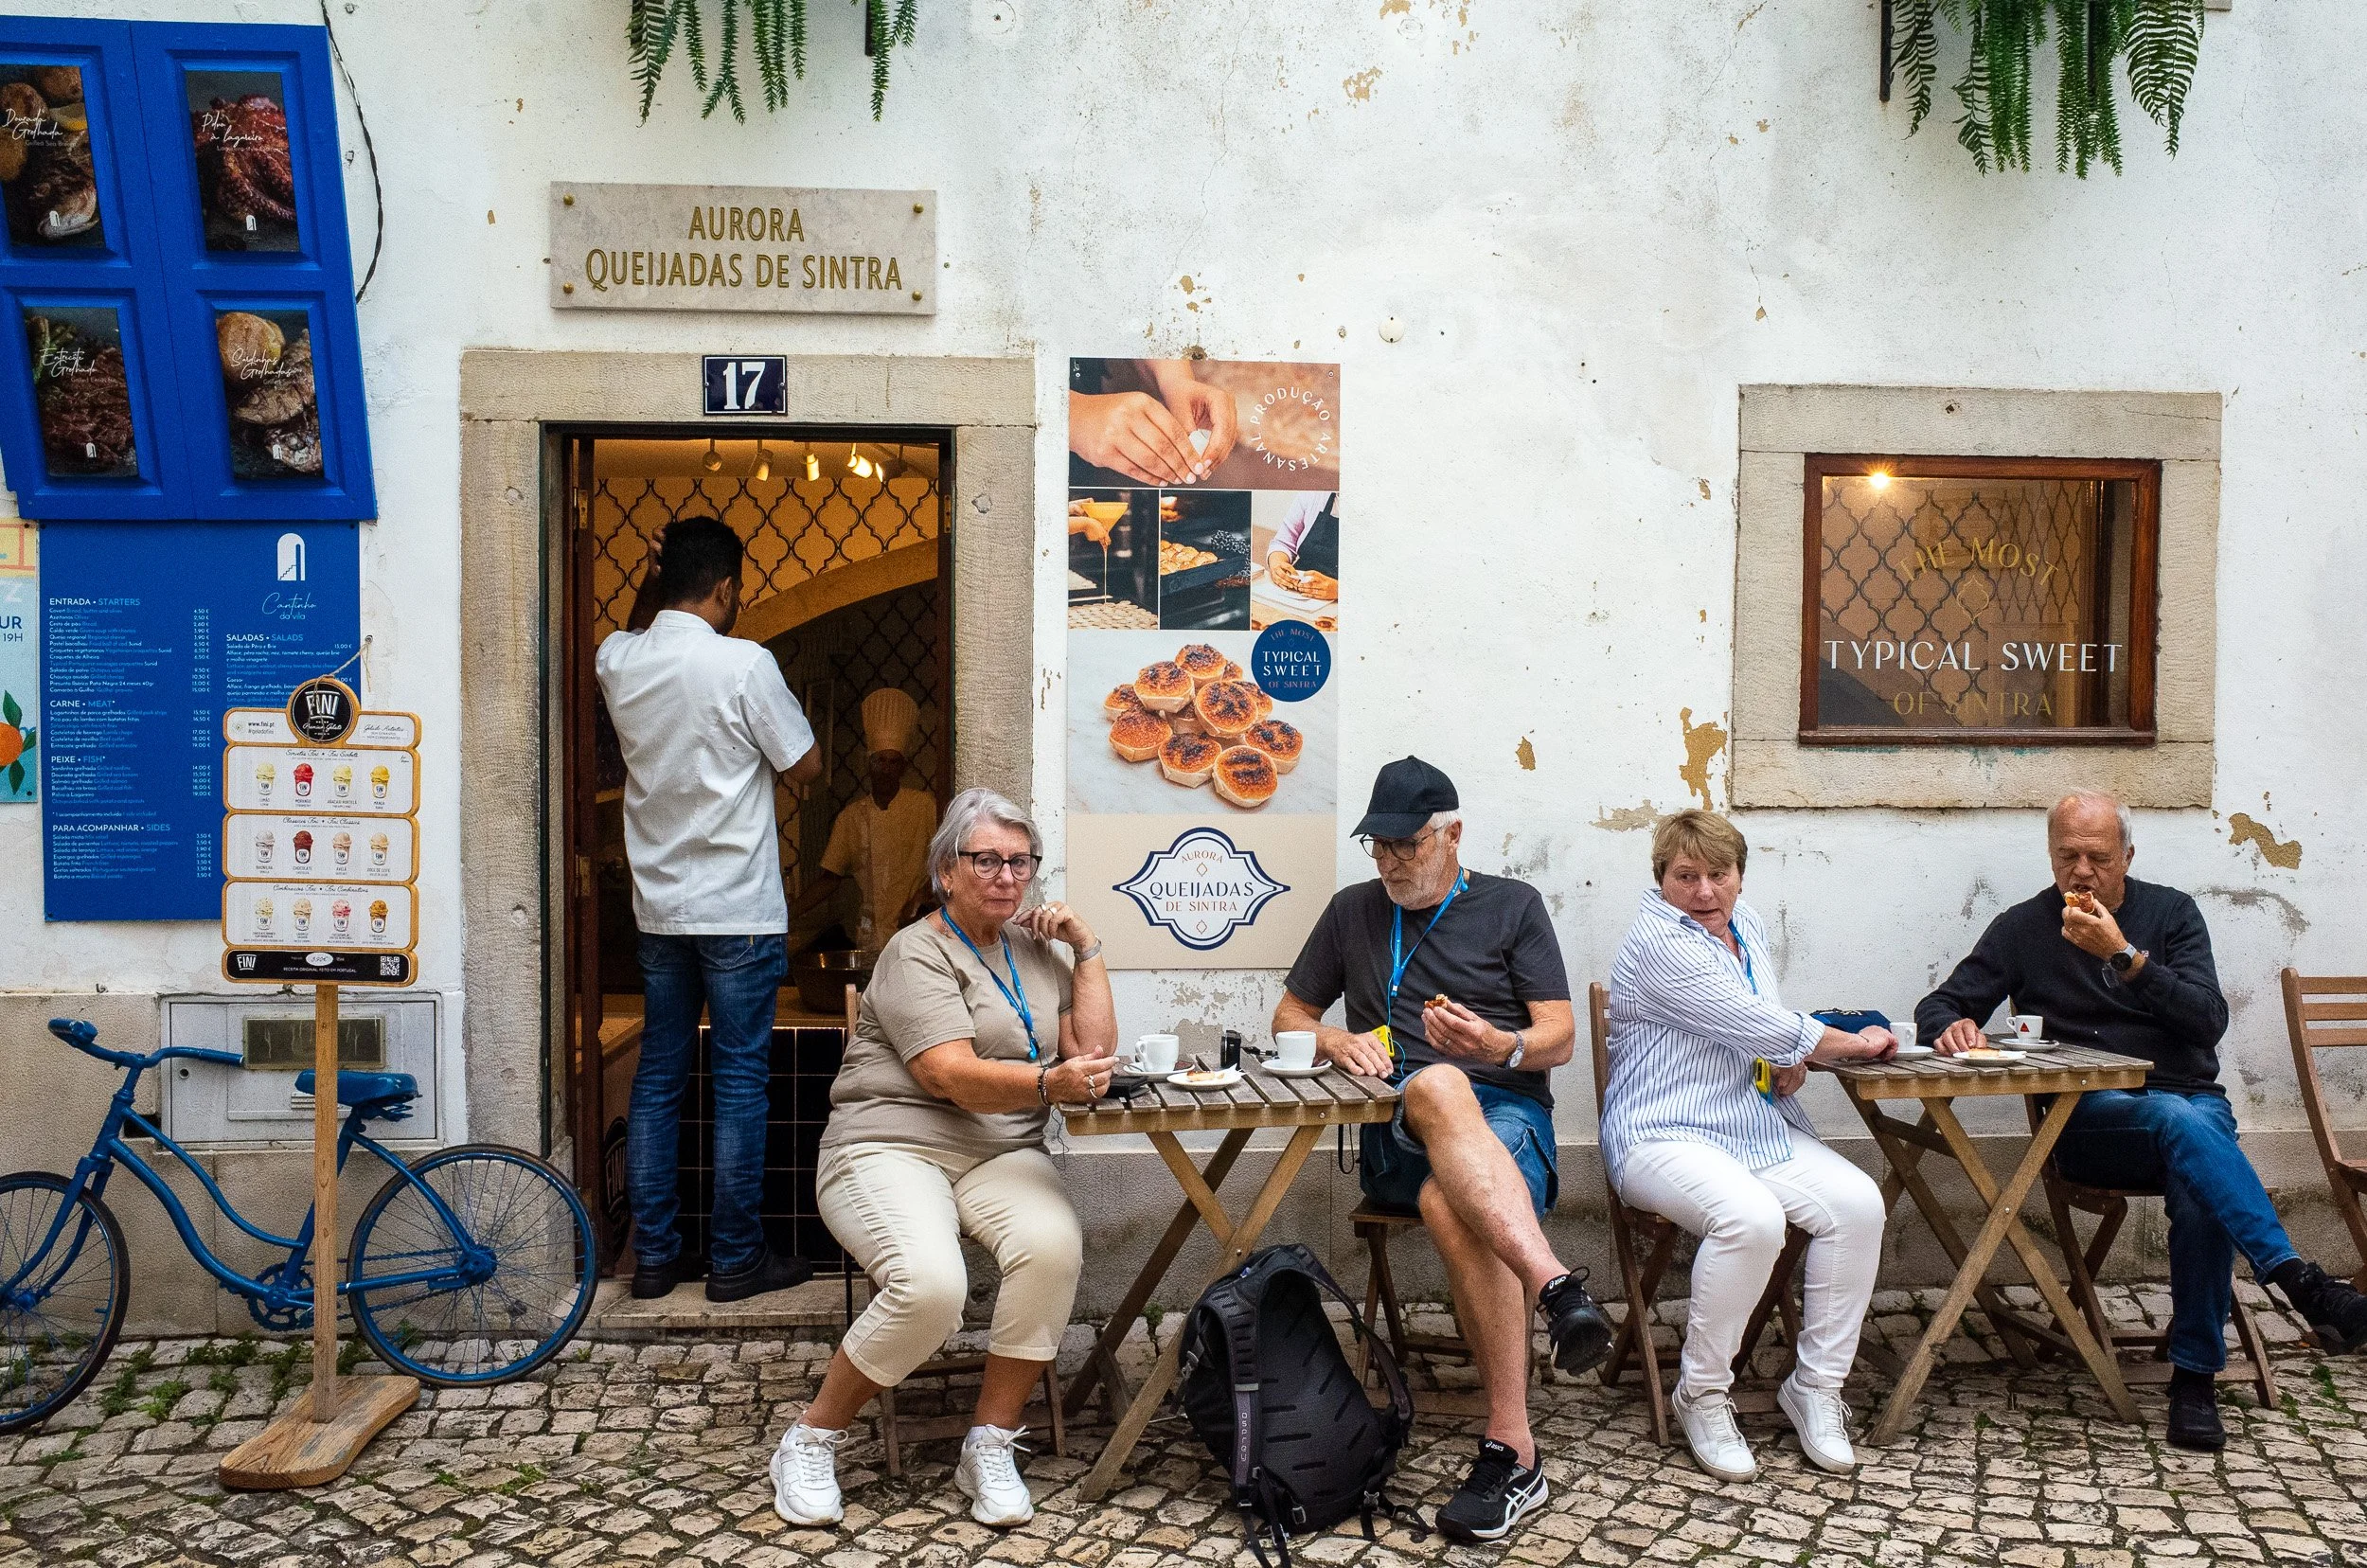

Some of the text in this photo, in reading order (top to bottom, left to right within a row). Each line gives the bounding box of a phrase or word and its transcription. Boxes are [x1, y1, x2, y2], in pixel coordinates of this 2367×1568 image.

[688, 205, 805, 241] AURORA
[585, 248, 902, 292] QUEIJADAS DE SINTRA
[722, 361, 766, 410] 17
[1249, 386, 1331, 425] PRODUÇÃO
[1250, 432, 1332, 472] ARTESANAL
[1898, 536, 2059, 586] THE MOST
[49, 597, 141, 607] ENTRADA STARTERS
[3, 633, 23, 643] 19H
[1262, 650, 1321, 663] TYPICAL
[1824, 640, 2123, 673] TYPICAL SWEET
[1263, 665, 1322, 677] SWEET
[1284, 681, 1317, 689] SINTRA
[50, 700, 80, 708] CARNE
[1894, 691, 1933, 716] OF
[51, 755, 76, 763] PEIXE
[53, 824, 170, 832] PARA ACOMPANHAR SIDES
[1181, 849, 1224, 864] AURORA
[1148, 881, 1255, 900] QUEIJADAS
[1165, 900, 1237, 912] DE SINTRA
[237, 955, 257, 969] FINI
